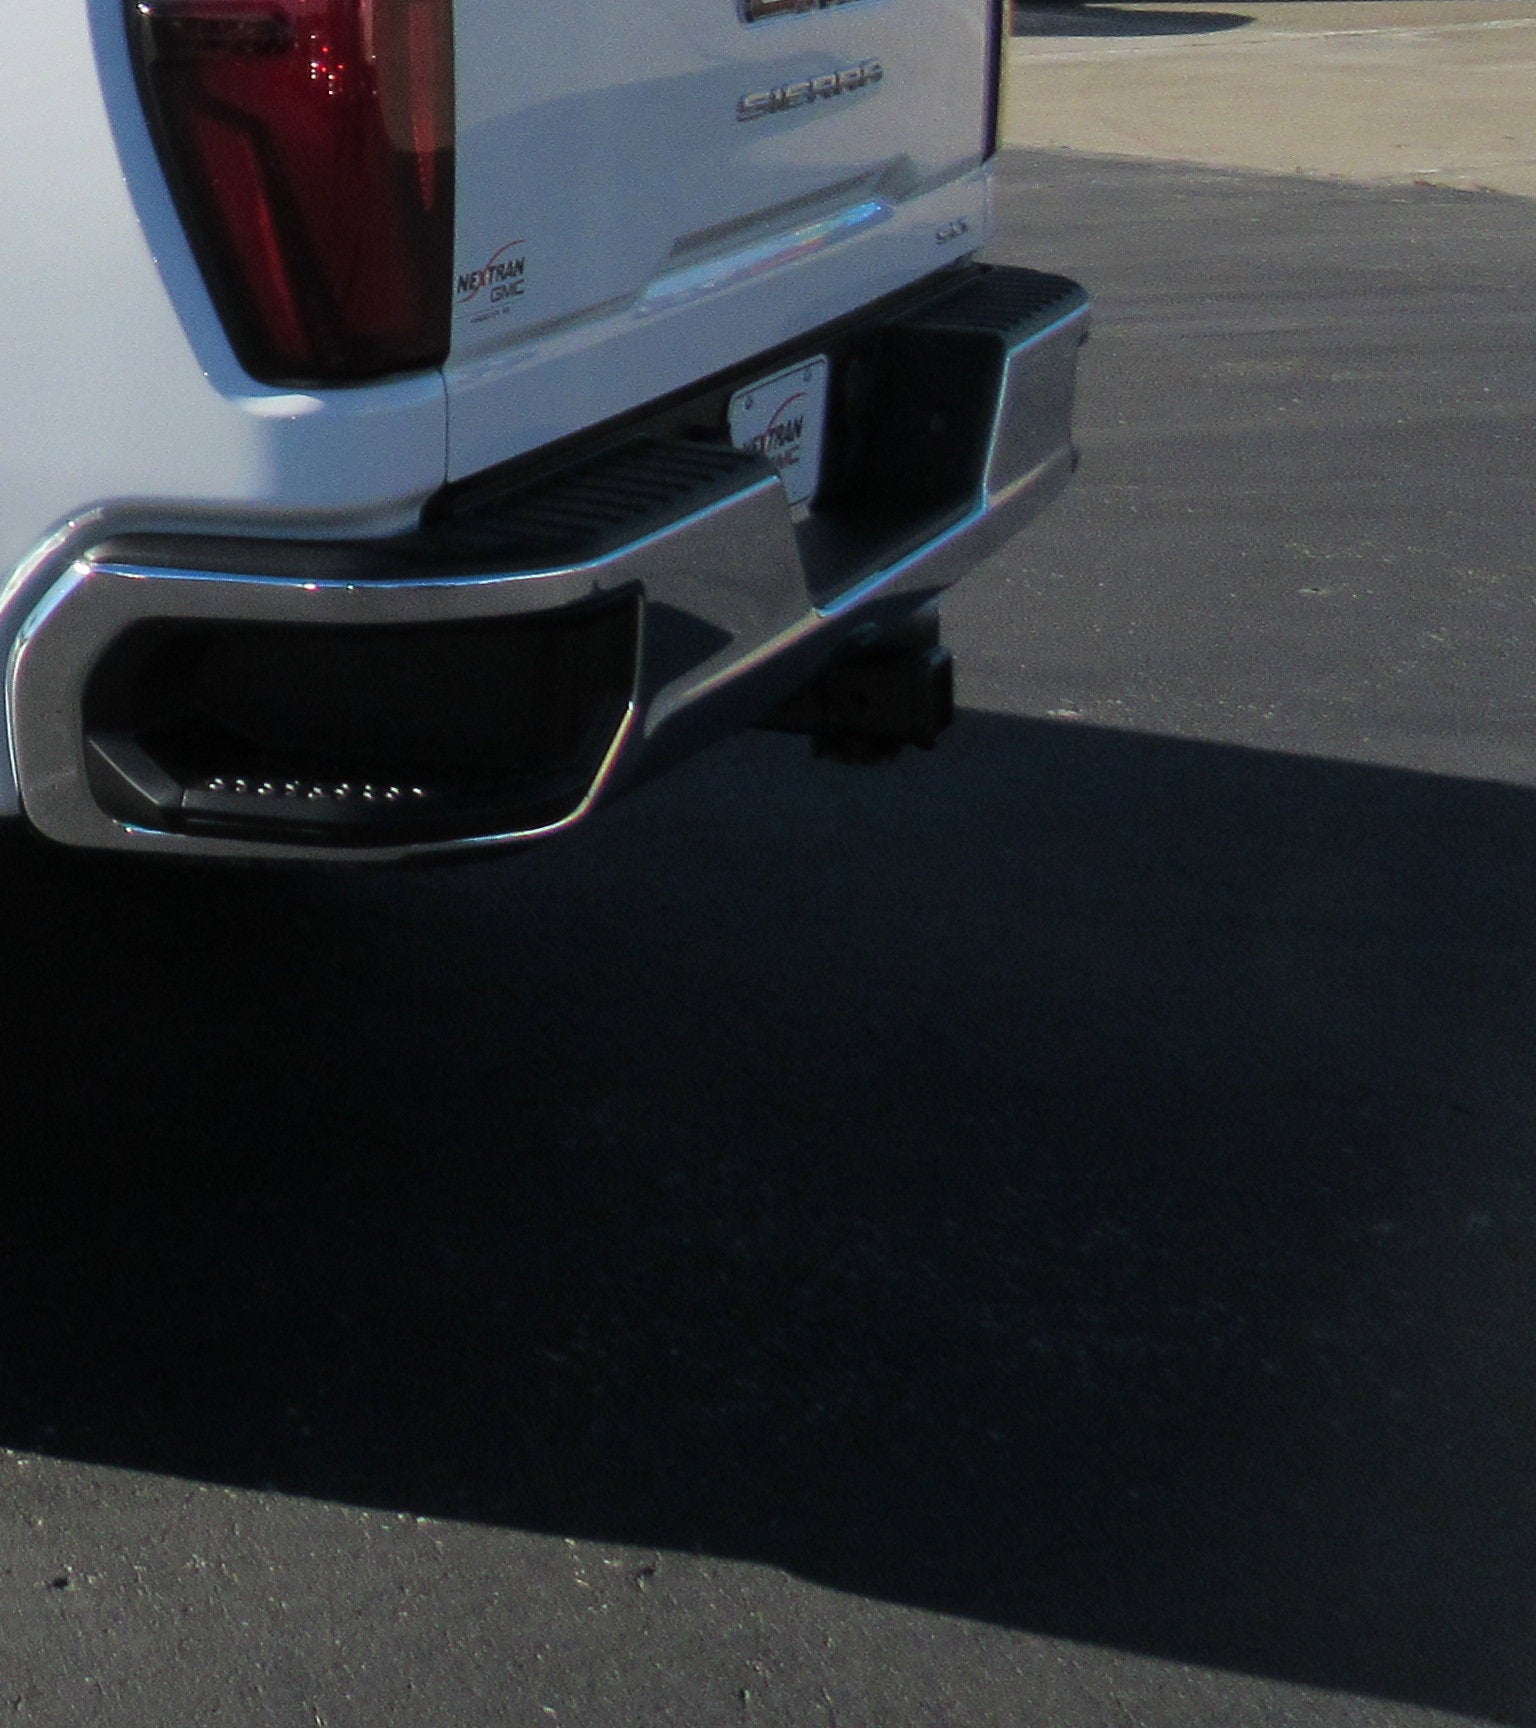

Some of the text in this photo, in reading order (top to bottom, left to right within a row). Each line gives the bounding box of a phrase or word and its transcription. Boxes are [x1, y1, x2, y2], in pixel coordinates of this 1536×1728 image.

[737, 59, 884, 123] SIERRA
[457, 256, 526, 294] NEXTRAN
[490, 278, 526, 303] GMC
